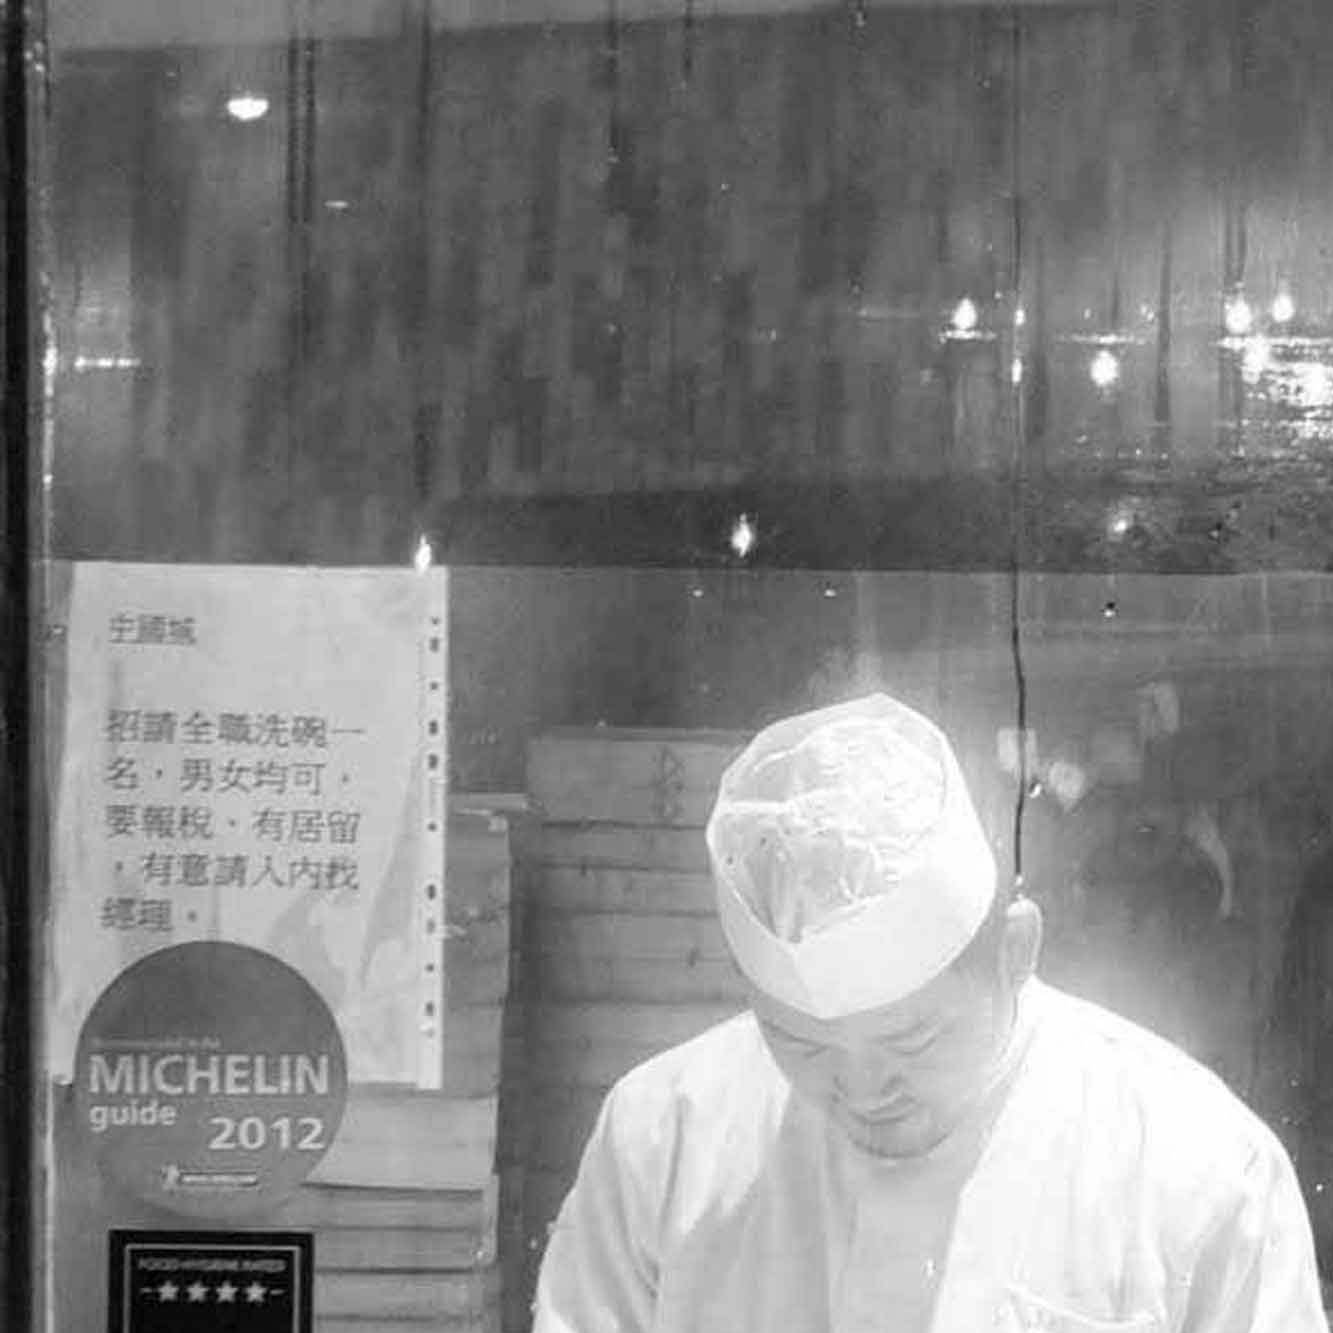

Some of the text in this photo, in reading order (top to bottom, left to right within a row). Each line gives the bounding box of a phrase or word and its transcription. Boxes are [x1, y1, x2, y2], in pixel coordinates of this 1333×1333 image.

[88, 1053, 329, 1094] MICHELIN
[88, 1101, 178, 1133] guide
[208, 1116, 326, 1150] 2012
